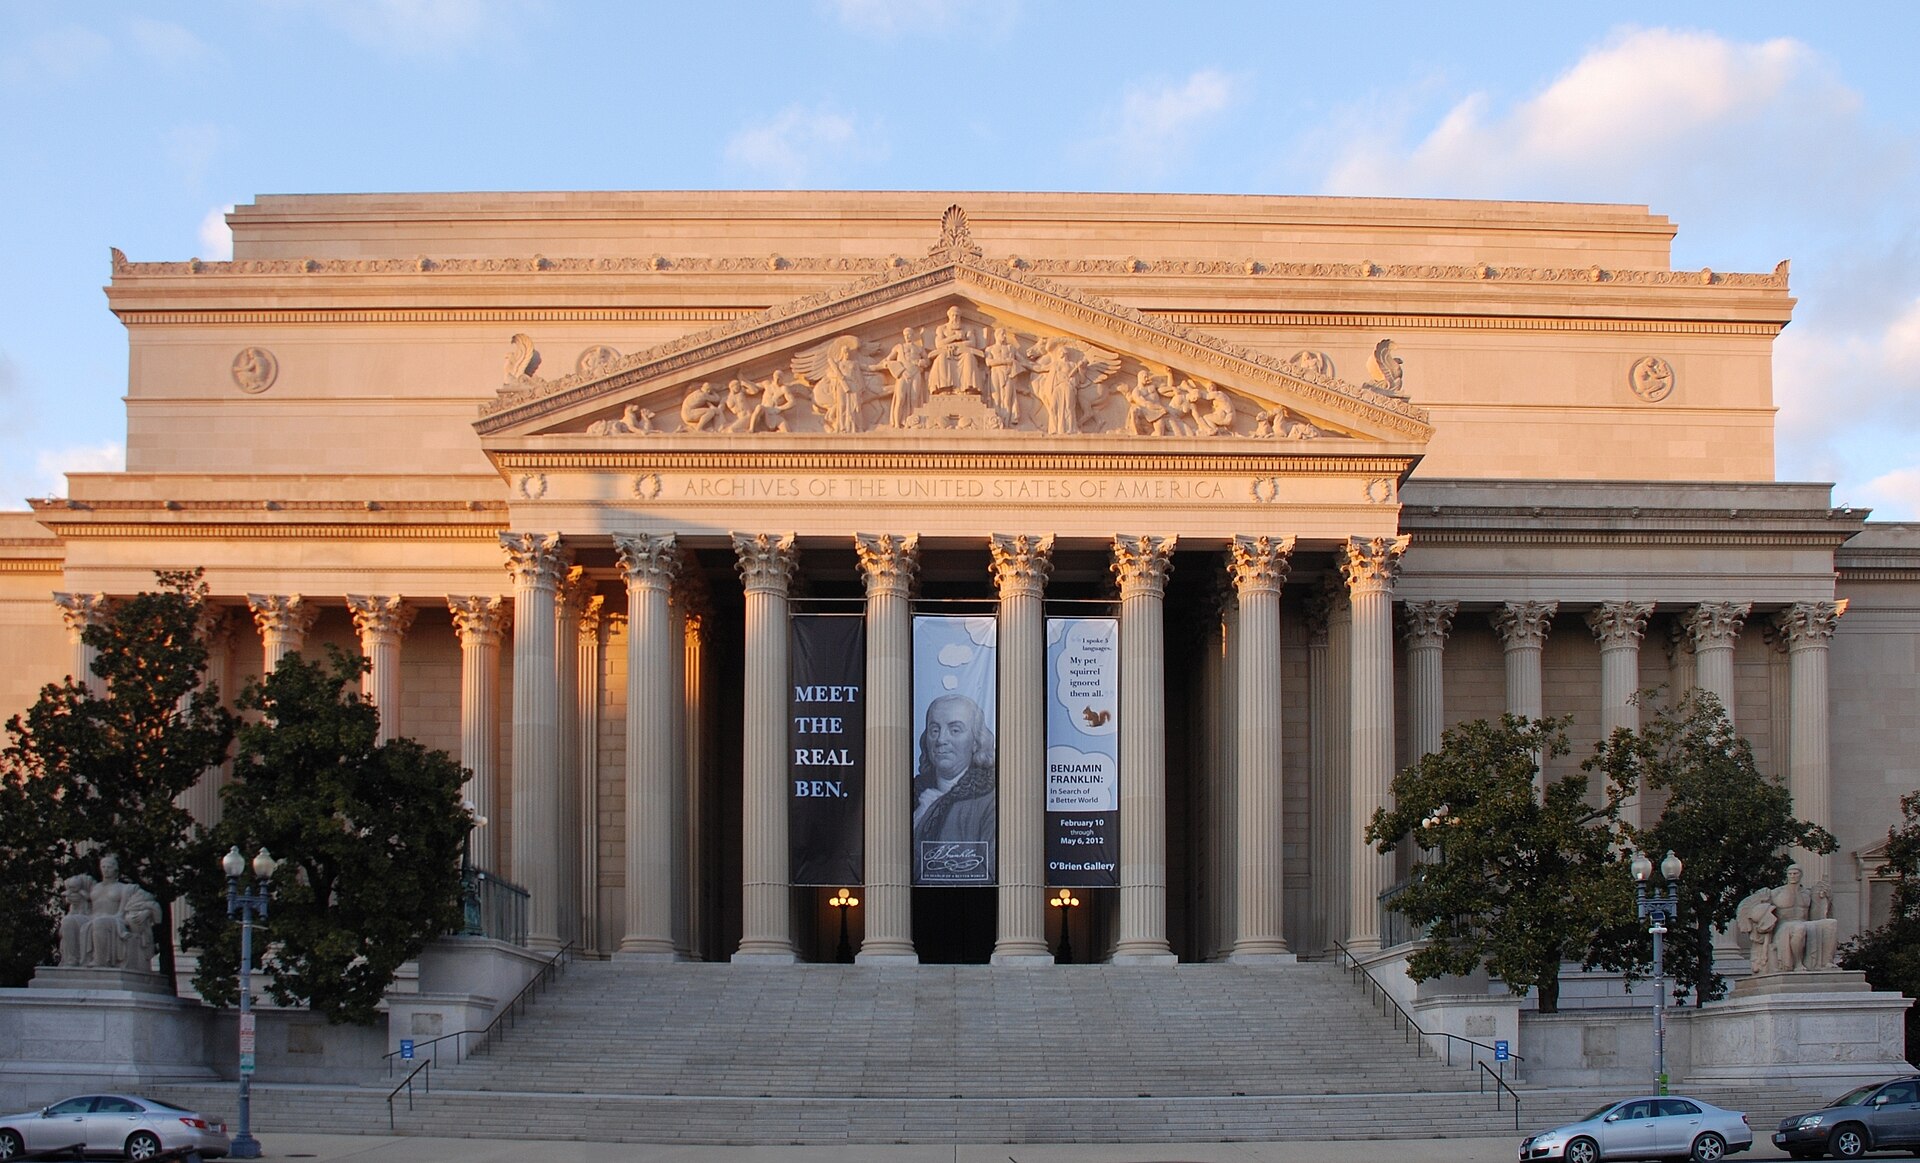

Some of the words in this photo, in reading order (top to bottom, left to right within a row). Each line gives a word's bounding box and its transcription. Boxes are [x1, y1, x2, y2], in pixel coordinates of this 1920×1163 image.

[684, 478, 800, 497] ARCHIVES
[808, 478, 838, 497] OF
[844, 478, 888, 497] THE
[897, 479, 984, 498] UNITED
[993, 480, 1071, 498] STATES
[1079, 480, 1108, 498] OF
[1114, 480, 1225, 499] AMERICA
[1070, 656, 1082, 666] My
[1084, 658, 1097, 666] pet
[1070, 668, 1100, 677] squirrel
[1070, 679, 1100, 688] ignored
[794, 685, 859, 702] MEET
[794, 717, 843, 733] THE
[794, 749, 854, 766] REAL
[1050, 764, 1102, 772] BENJAMIN
[1050, 775, 1104, 784] FRANKLIN:
[794, 780, 848, 798] BEN.
[1060, 819, 1094, 828] February
[1060, 837, 1076, 846] May
[1077, 837, 1084, 845] 6,
[1049, 861, 1082, 870] O'Brien
[1083, 861, 1115, 872] Gallery
